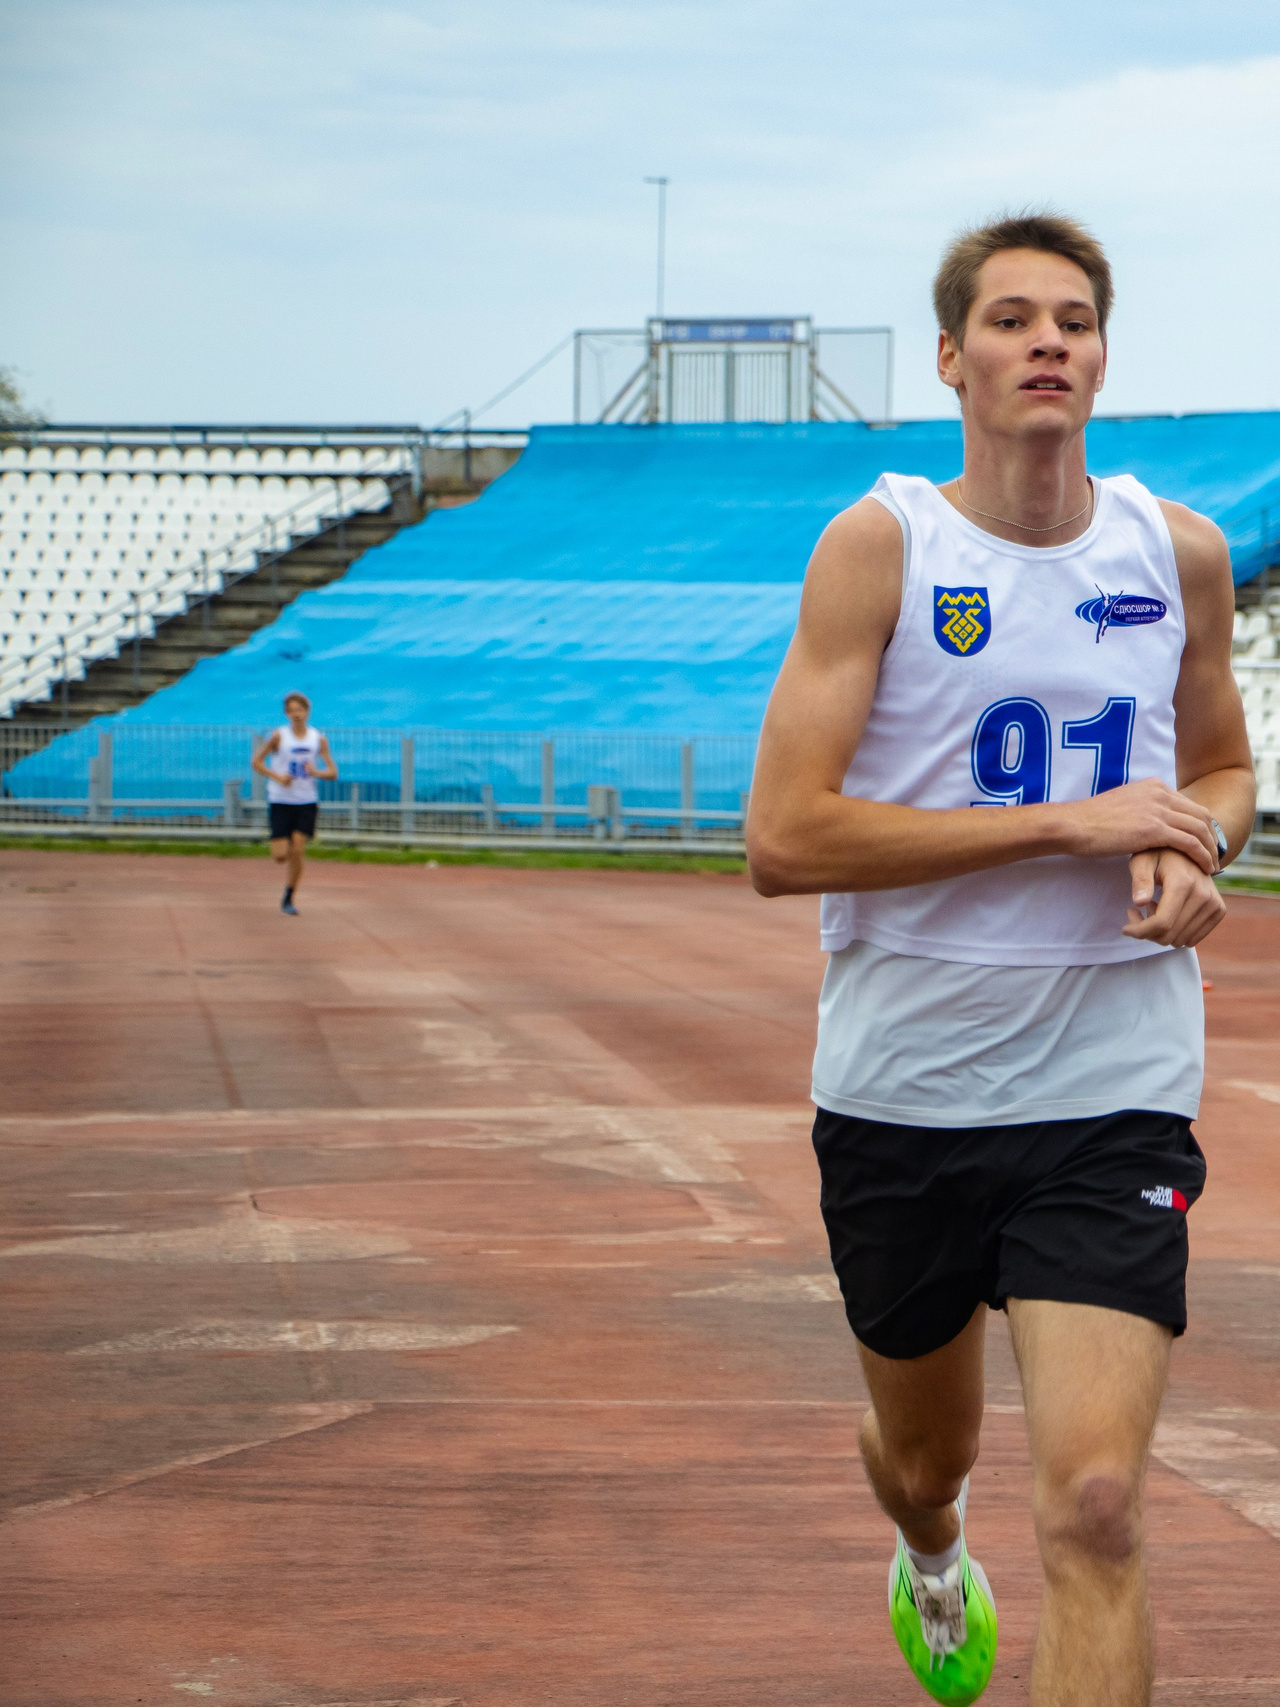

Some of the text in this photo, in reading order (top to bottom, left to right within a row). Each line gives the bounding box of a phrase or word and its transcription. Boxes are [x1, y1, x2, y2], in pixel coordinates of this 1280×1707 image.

[1114, 604, 1151, 615] СДЮСШОР
[1160, 604, 1165, 612] 3
[970, 696, 1137, 808] 91
